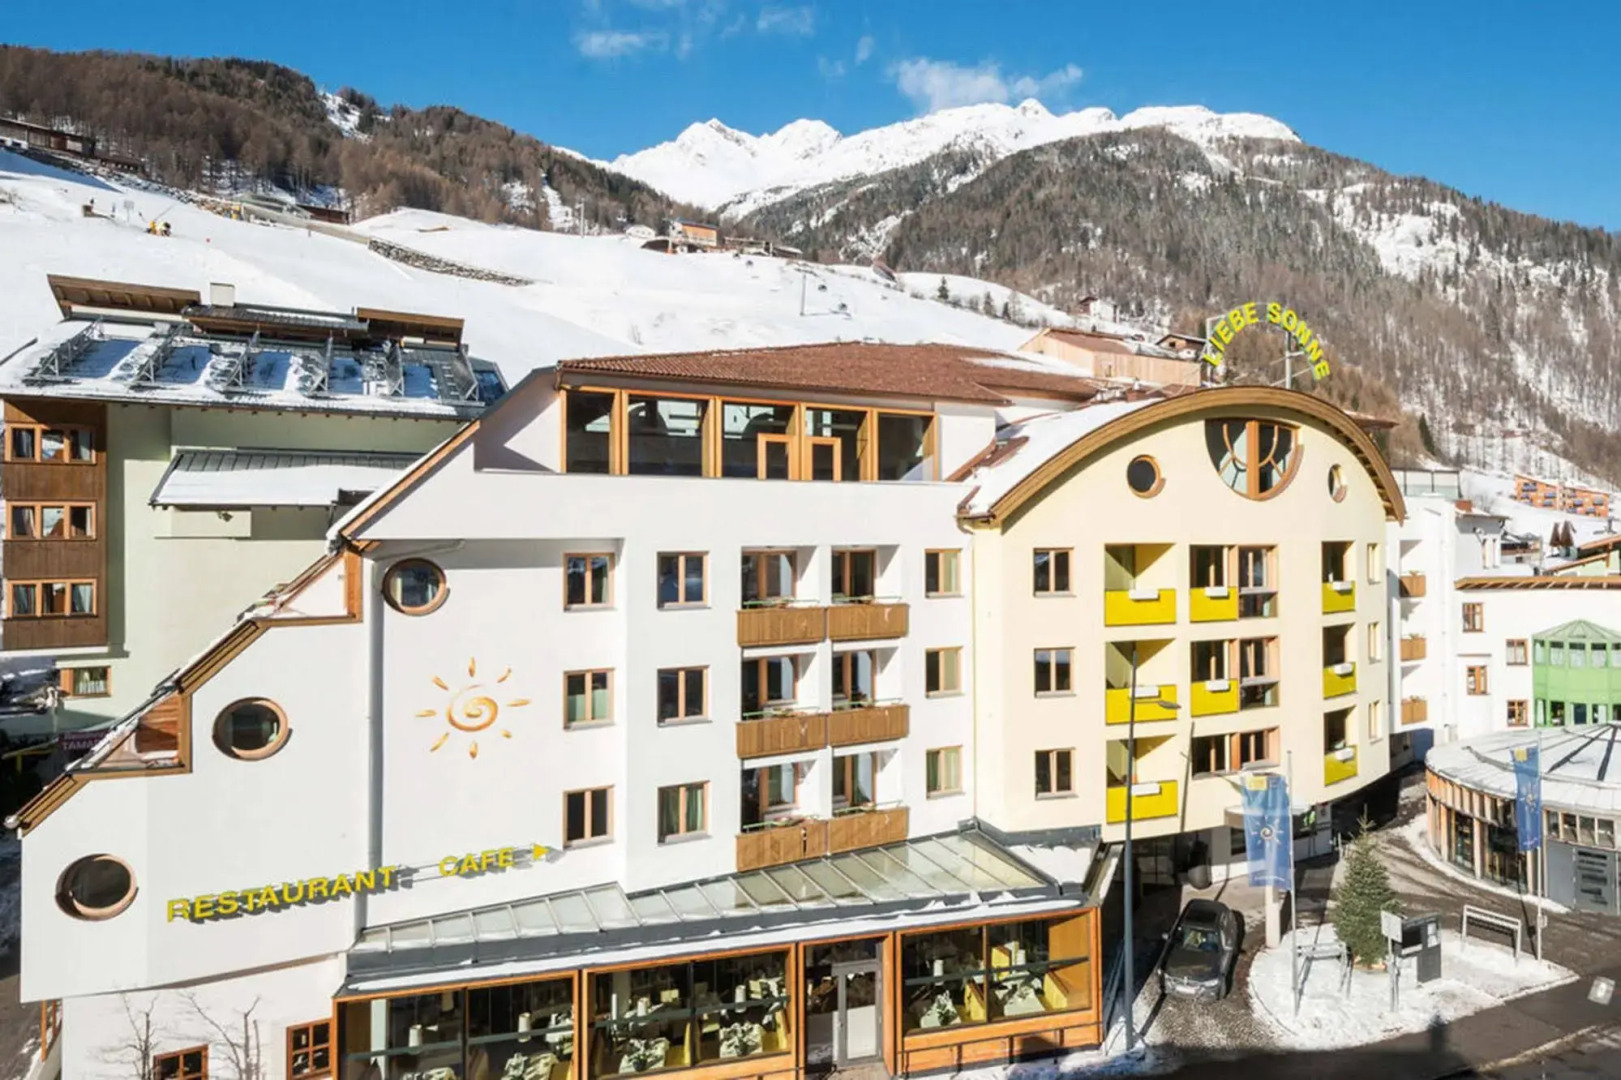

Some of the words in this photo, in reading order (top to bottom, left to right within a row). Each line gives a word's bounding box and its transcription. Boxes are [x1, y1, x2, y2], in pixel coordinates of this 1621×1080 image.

[1203, 301, 1259, 367] LIEBE
[1267, 301, 1331, 380] SONNE
[167, 865, 396, 922] RESTAURANT
[439, 846, 514, 877] CAFE
